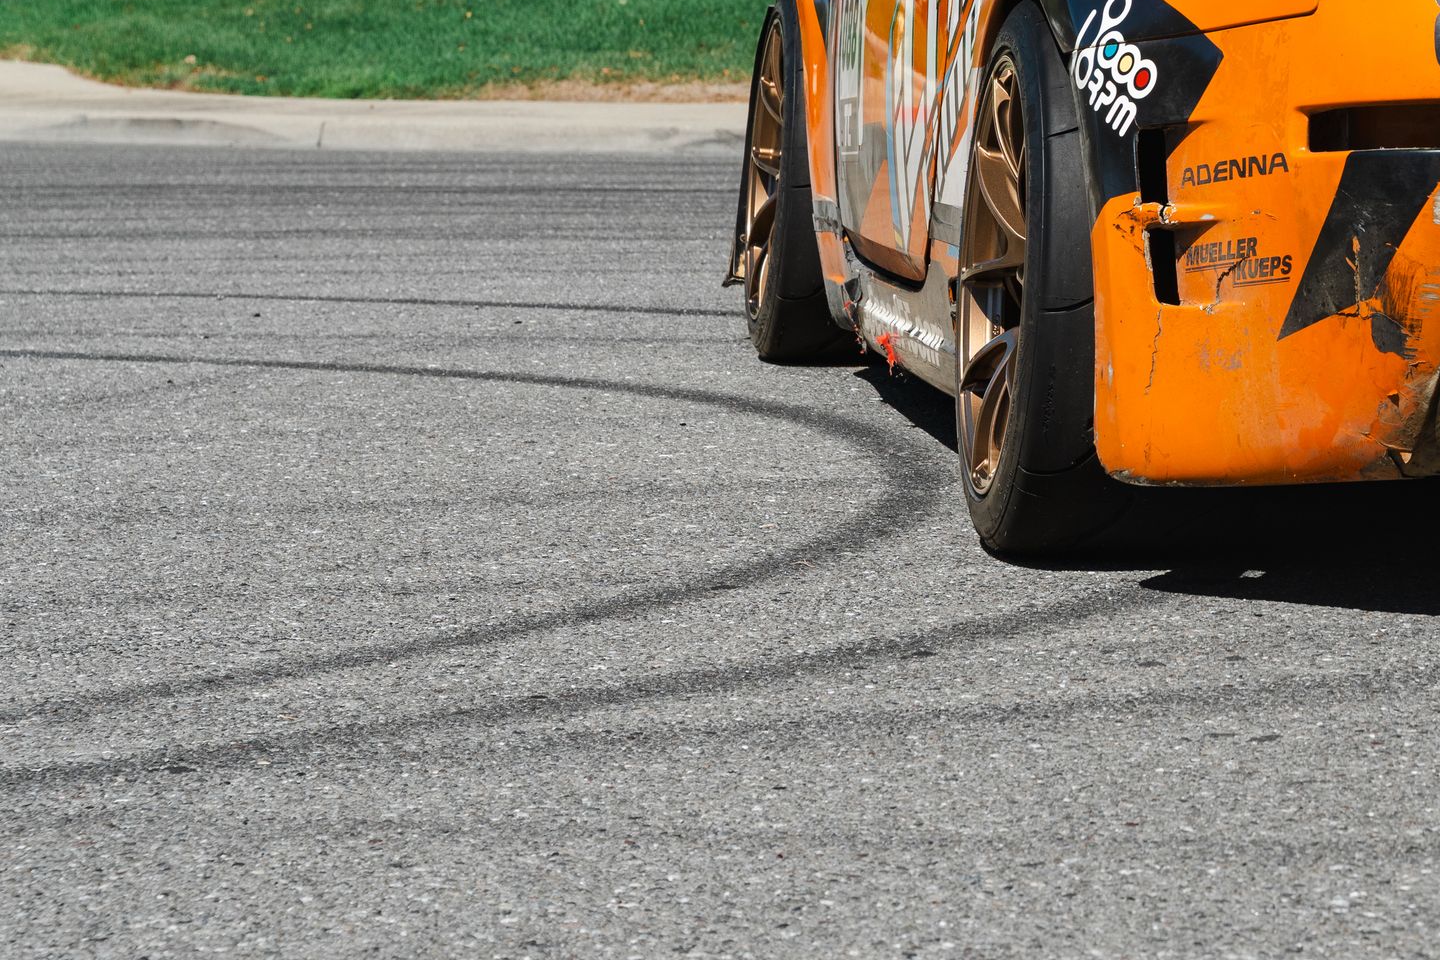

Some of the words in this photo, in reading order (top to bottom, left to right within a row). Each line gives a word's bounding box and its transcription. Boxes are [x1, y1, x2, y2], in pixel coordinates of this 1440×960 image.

[1181, 152, 1289, 189] ADENNA
[1185, 237, 1258, 267] MUELLER
[1234, 254, 1293, 282] KUEPS
